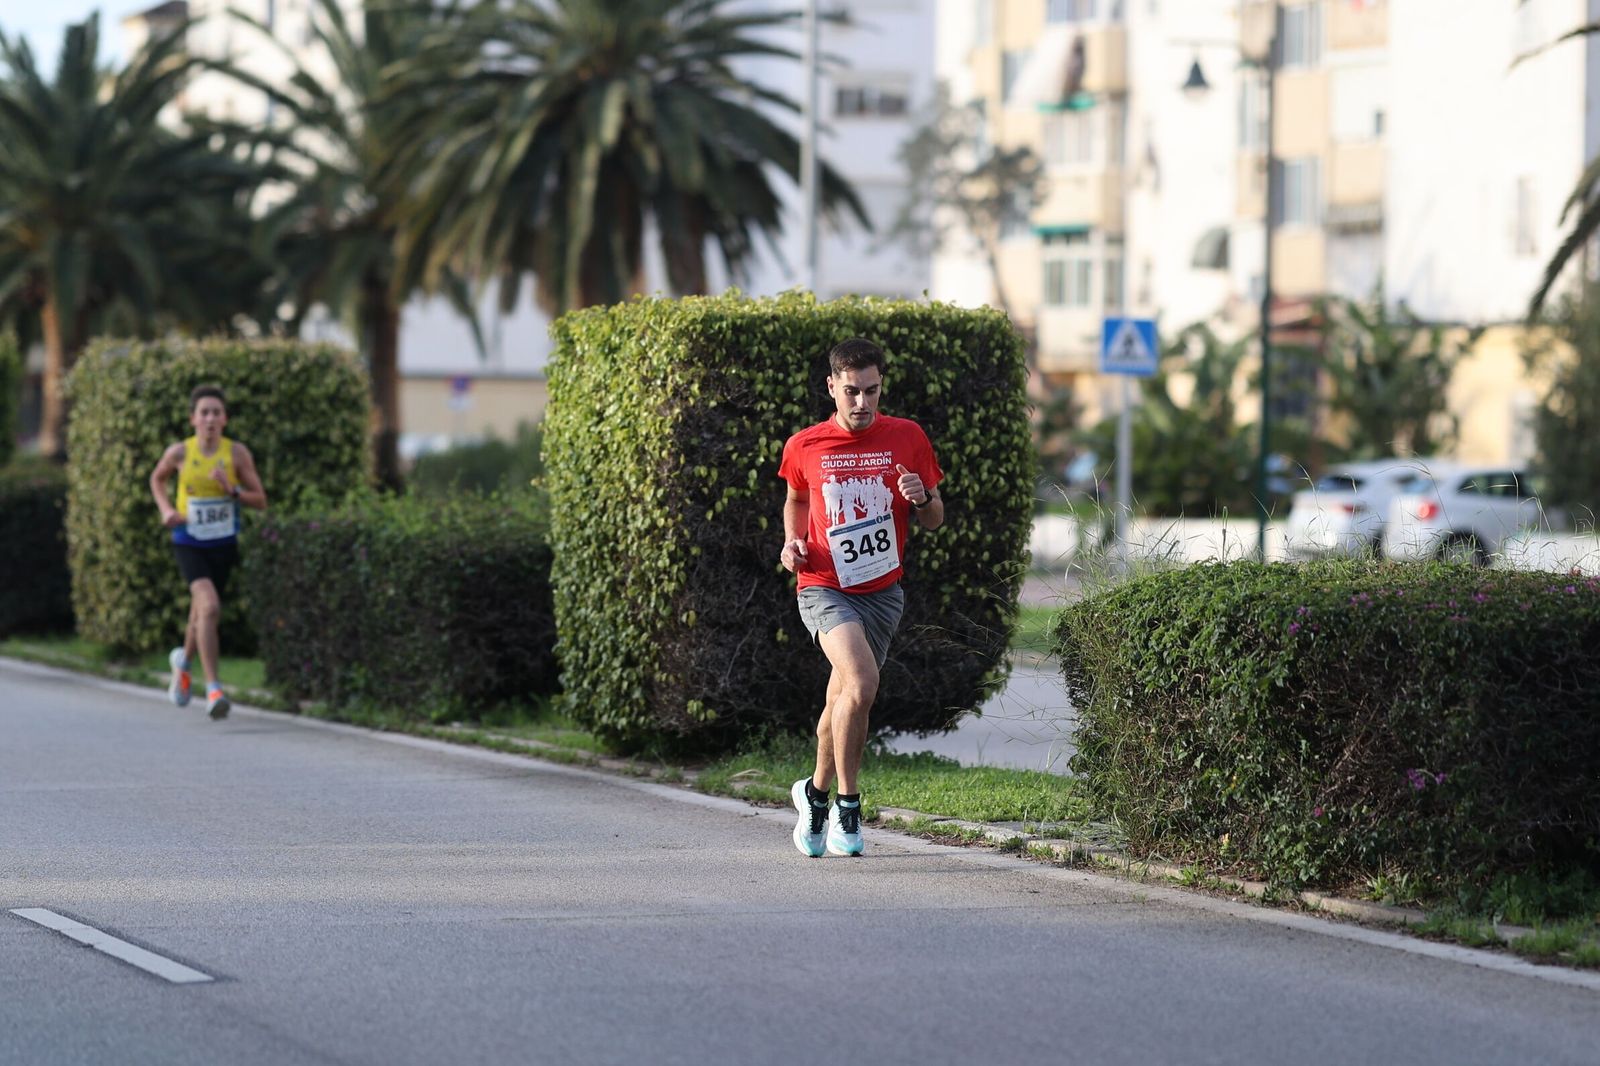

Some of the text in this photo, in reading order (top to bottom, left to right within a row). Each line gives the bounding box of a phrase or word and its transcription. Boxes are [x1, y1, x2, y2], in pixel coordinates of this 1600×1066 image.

[821, 456, 892, 468] CIUDAD JARDÍN
[840, 528, 890, 564] 348
